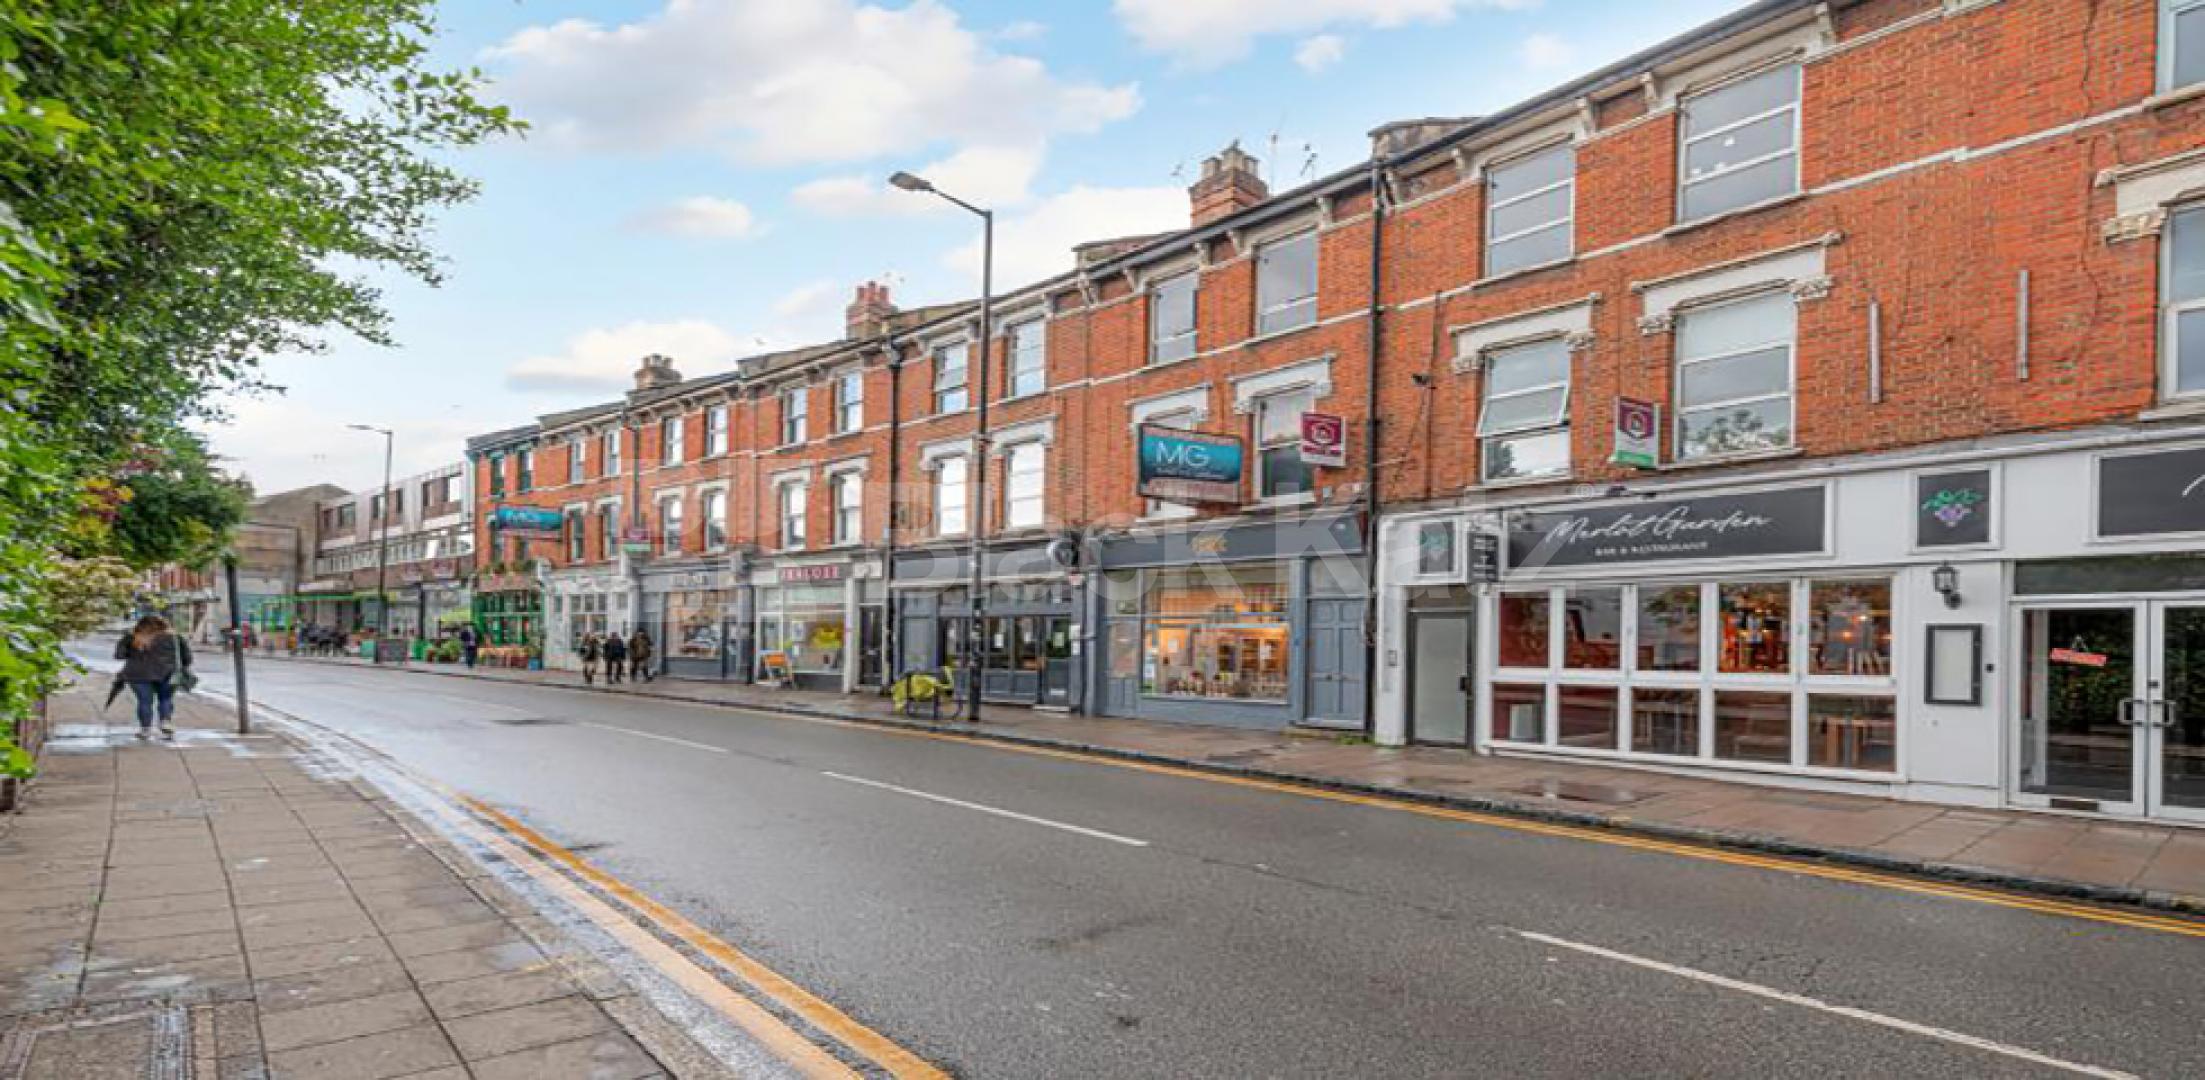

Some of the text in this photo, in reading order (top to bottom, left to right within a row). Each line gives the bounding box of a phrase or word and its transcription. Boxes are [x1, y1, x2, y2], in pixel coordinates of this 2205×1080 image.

[1155, 441, 1209, 466] MG
[1545, 505, 1773, 543] Merlot Garden
